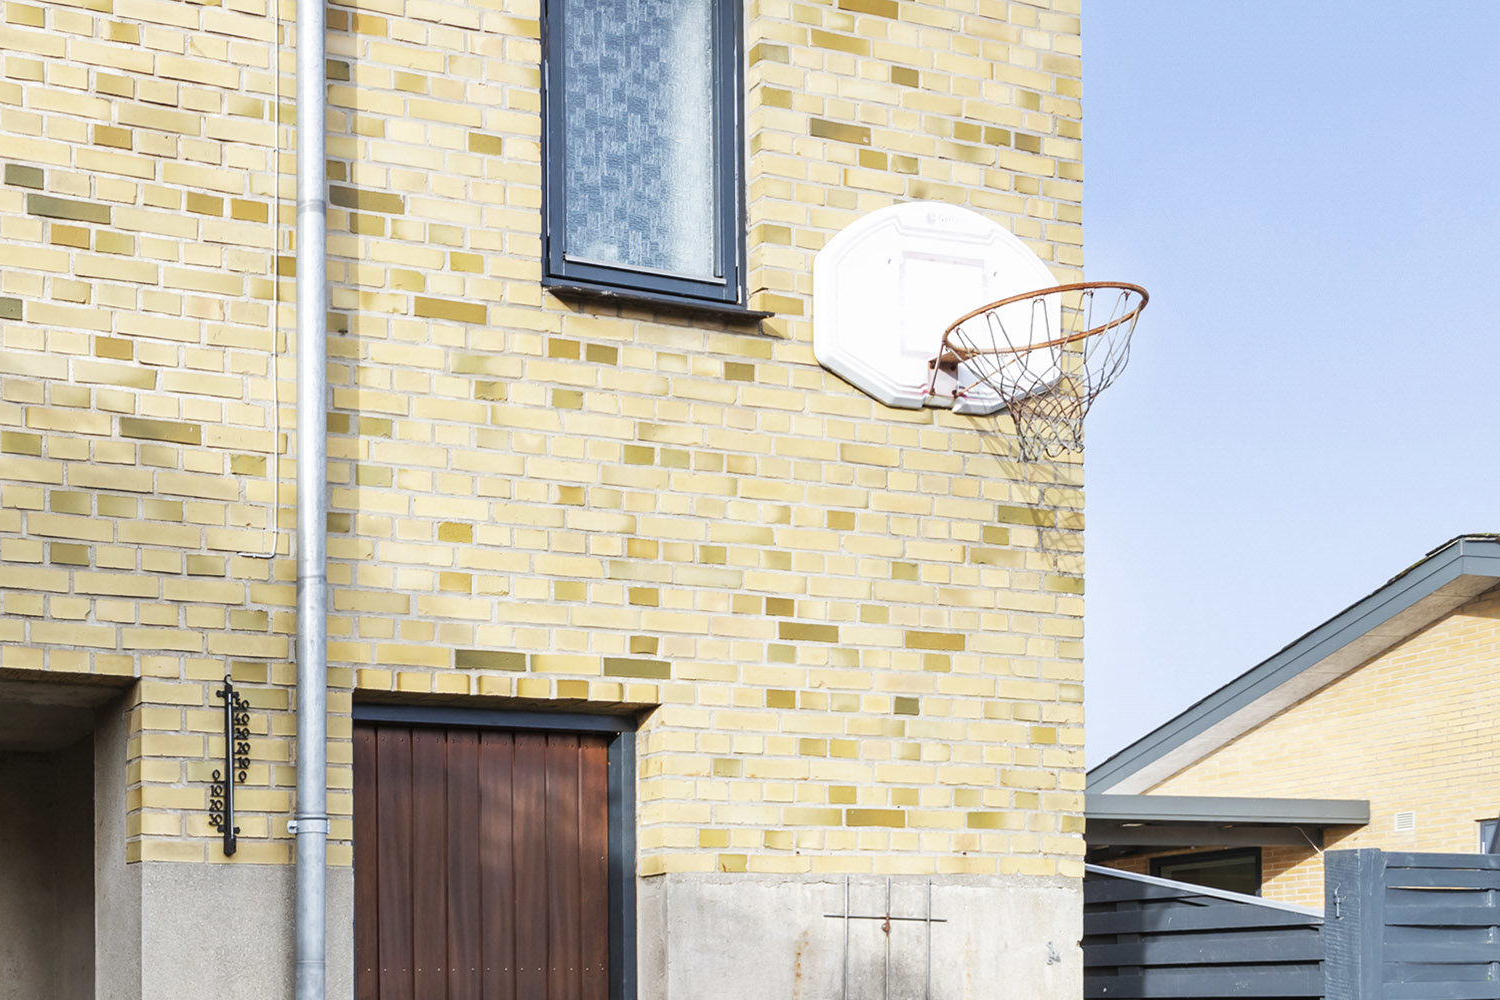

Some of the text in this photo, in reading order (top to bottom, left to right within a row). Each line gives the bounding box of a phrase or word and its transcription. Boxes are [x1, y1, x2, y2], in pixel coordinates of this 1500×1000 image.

[235, 698, 250, 710] 50
[235, 713, 250, 725] 40
[235, 727, 250, 740] 30
[236, 742, 251, 755] 20
[237, 756, 250, 769] 10
[212, 769, 221, 782] 0
[238, 770, 247, 783] 0
[210, 785, 222, 797] 10
[209, 799, 223, 812] 20
[208, 813, 223, 826] 30
